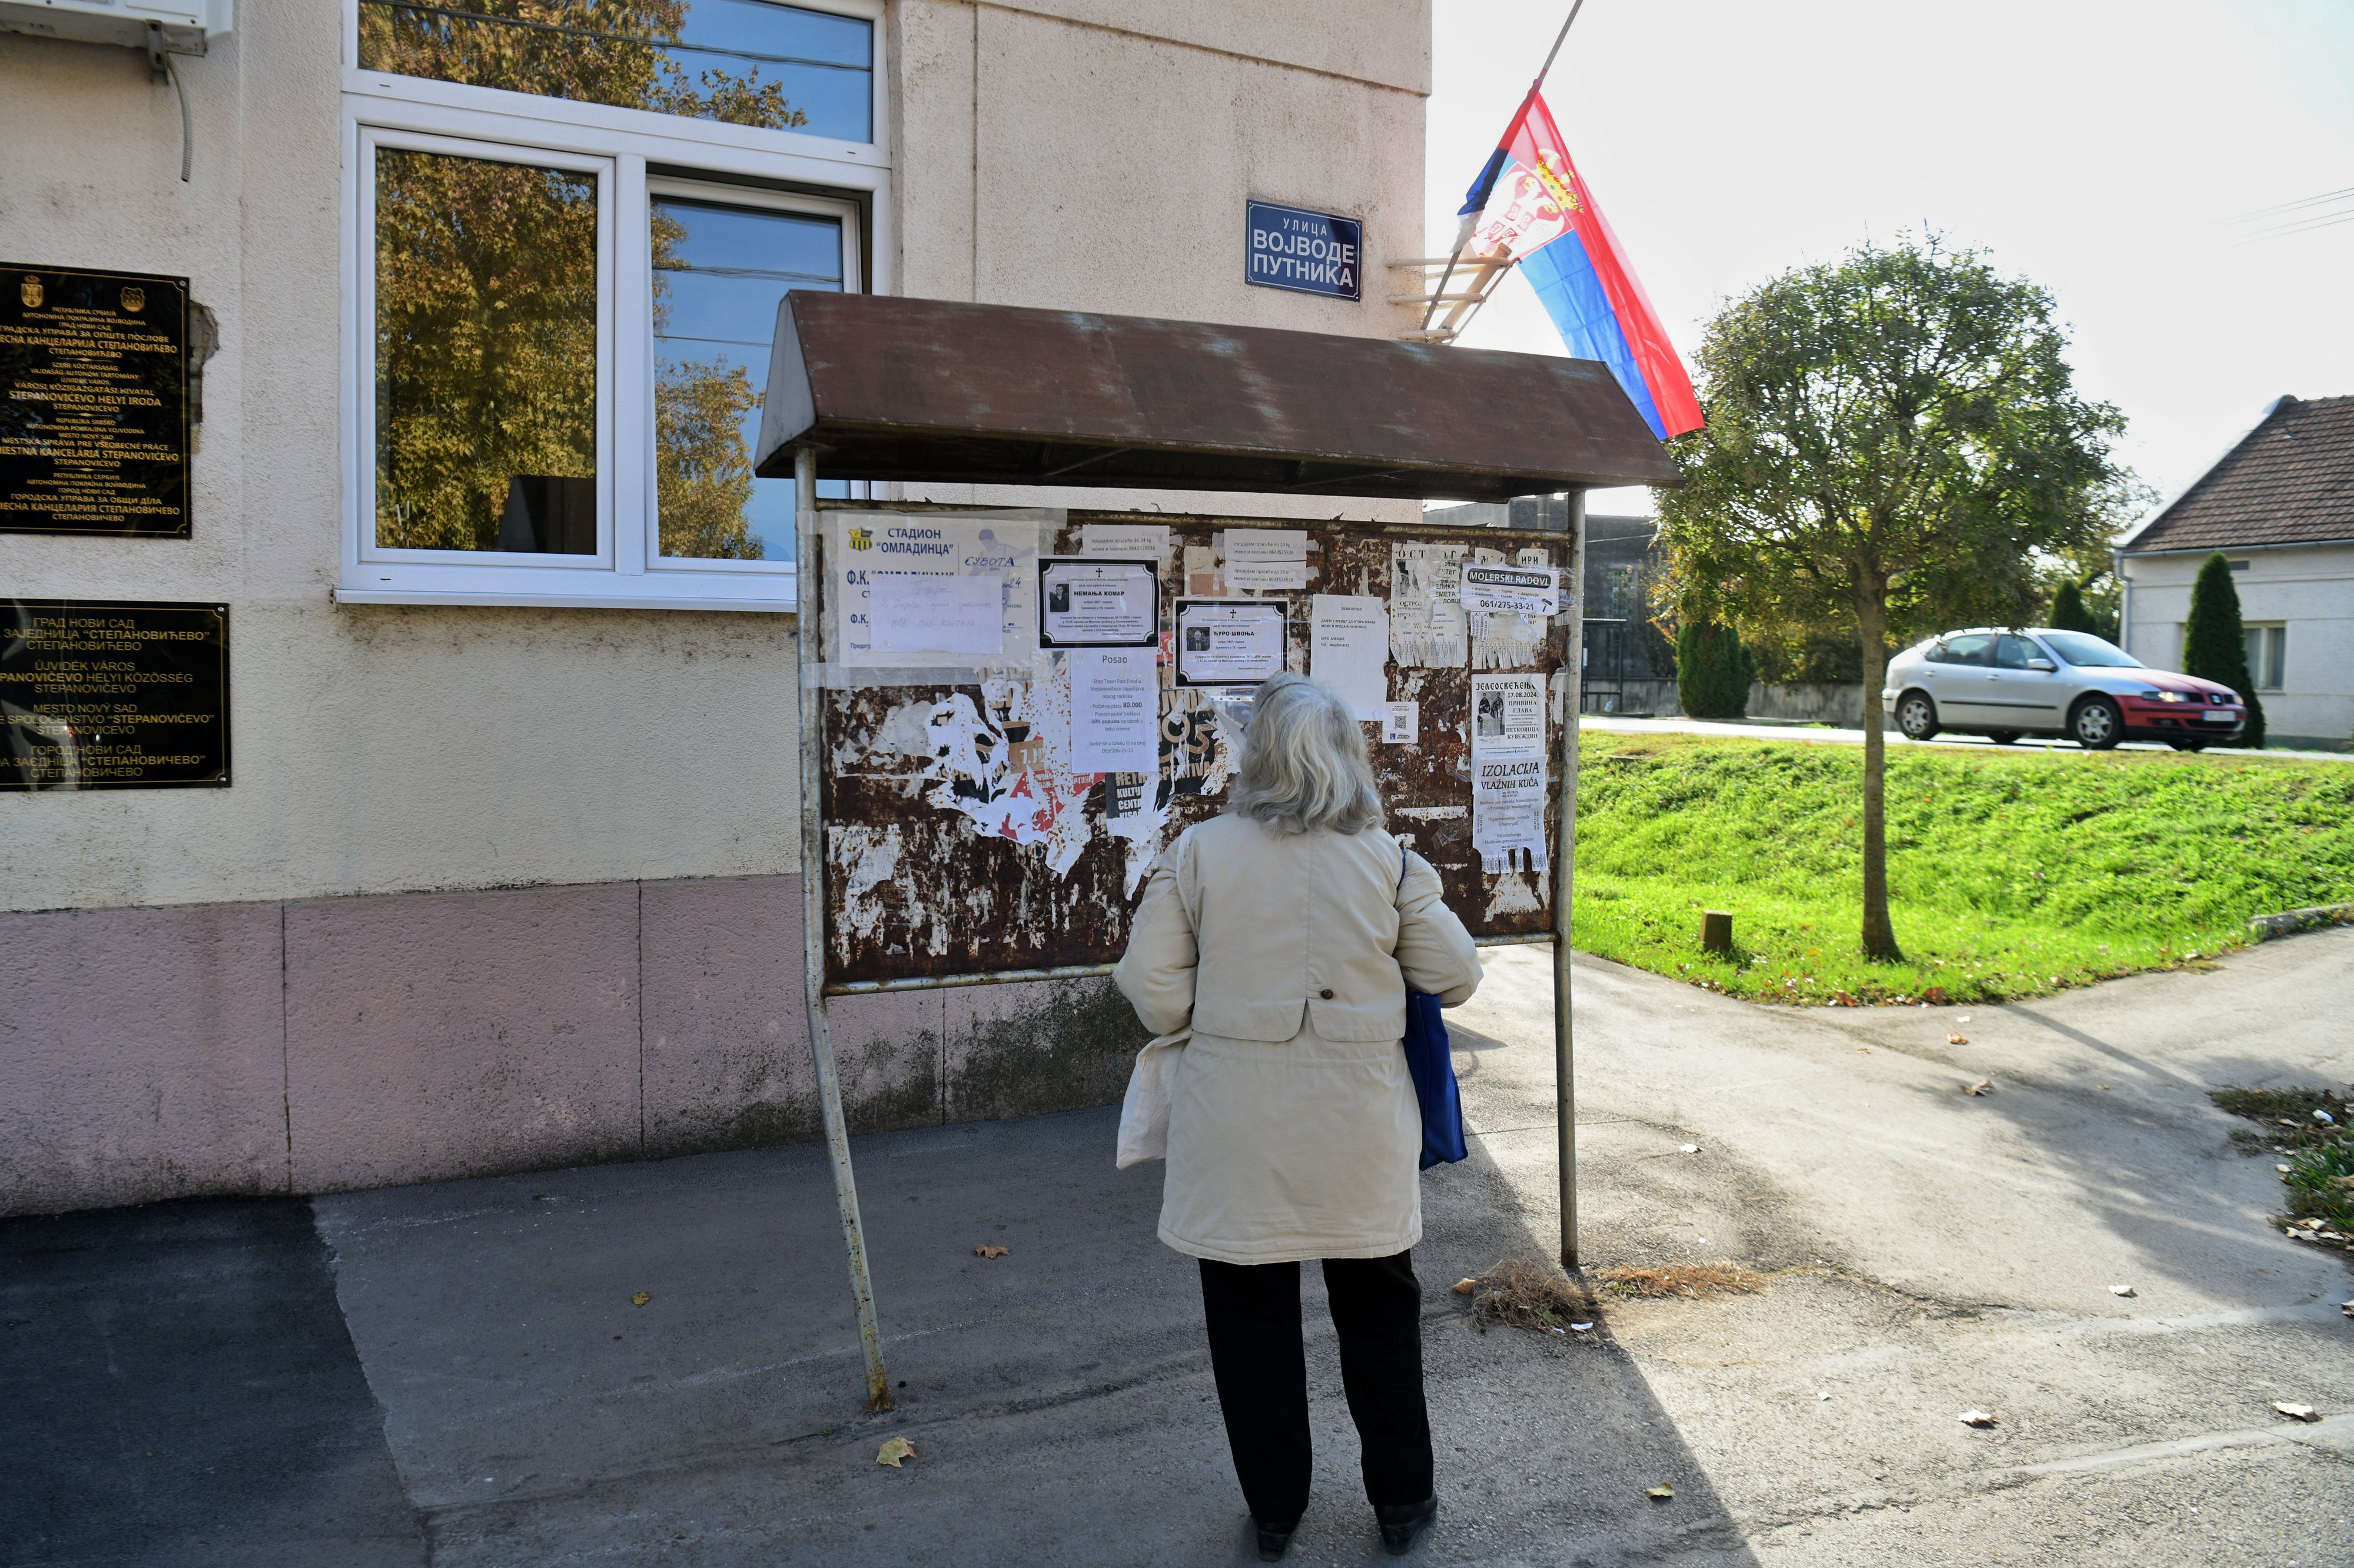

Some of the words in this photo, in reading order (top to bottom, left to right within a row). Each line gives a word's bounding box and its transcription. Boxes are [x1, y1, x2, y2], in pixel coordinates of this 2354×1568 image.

[1283, 218, 1327, 237] УЛИЦА
[1254, 229, 1354, 267] ВОЈВОДЕ
[1254, 253, 1353, 287] ПУТНИКА
[42, 327, 78, 337] УПРАВА
[93, 331, 125, 340] ОПШТЕ
[127, 334, 170, 343] ПОСЛОВЕ
[0, 334, 25, 344] ЕСНА
[27, 336, 97, 348] КАНЦЕЛАРИЈА
[98, 340, 178, 353] СТЕПАНОВИЋЕВО
[48, 347, 122, 358] СТЕПАНОВИЋЕВО
[9, 391, 95, 404] STEPANOVIĆEVO
[98, 394, 126, 405] HELYI
[128, 397, 162, 406] IRODA
[142, 443, 169, 451] PRÁCE
[39, 447, 101, 458] KANCELÁRIA
[102, 450, 179, 461] STEPANOVIĆEVO
[11, 493, 58, 501] ГОРОДСКА
[110, 497, 139, 505] ОБЩИ
[31, 503, 97, 513] КАНЦЕЛАРИЯ
[99, 505, 180, 515] СТЕПАНОВИЧЕВО
[52, 513, 125, 521] СТЕПАНОВИЧЕВО
[888, 528, 941, 540] СТАДИОН
[965, 556, 1014, 567] СУБОТА
[847, 569, 869, 585] Ф.К.
[1470, 572, 1512, 583] MOLERSKI
[1516, 575, 1548, 585] RADOVI
[1480, 600, 1533, 610] 061/275-33-21
[33, 618, 65, 629] ГРАД
[69, 619, 105, 628] НОВИ
[109, 619, 135, 629] САД
[851, 614, 869, 624] Ф.К.
[3, 628, 80, 641] ЗАЈЕДНИЦА
[26, 640, 141, 651] СТЕПАНОВИЋЕВО
[35, 659, 89, 671] ÚJVIDÉK
[92, 660, 135, 671] VÁROS
[1102, 655, 1128, 663] Posao
[0, 671, 82, 682] PANOVIĆEVO
[87, 673, 121, 683] HELYI
[125, 672, 194, 683] KÖZÖSSÉG
[34, 683, 137, 693] STEPANOVIĆEVO
[33, 704, 75, 713] MESTO
[78, 702, 111, 713] NOVÝ
[114, 704, 138, 713] SAD
[7, 713, 105, 725] SPOLOČENSTVO
[31, 745, 72, 756] ГОРОД
[77, 745, 112, 755] НОВИ
[116, 745, 141, 756] САД
[31, 768, 142, 778] СТЕПАНОВИЧЕВО
[1482, 762, 1539, 777] IZOLACIJA
[1481, 779, 1516, 790] VLAŽNIH
[1519, 777, 1539, 788] KUĆA
[1117, 786, 1141, 798] KULTU
